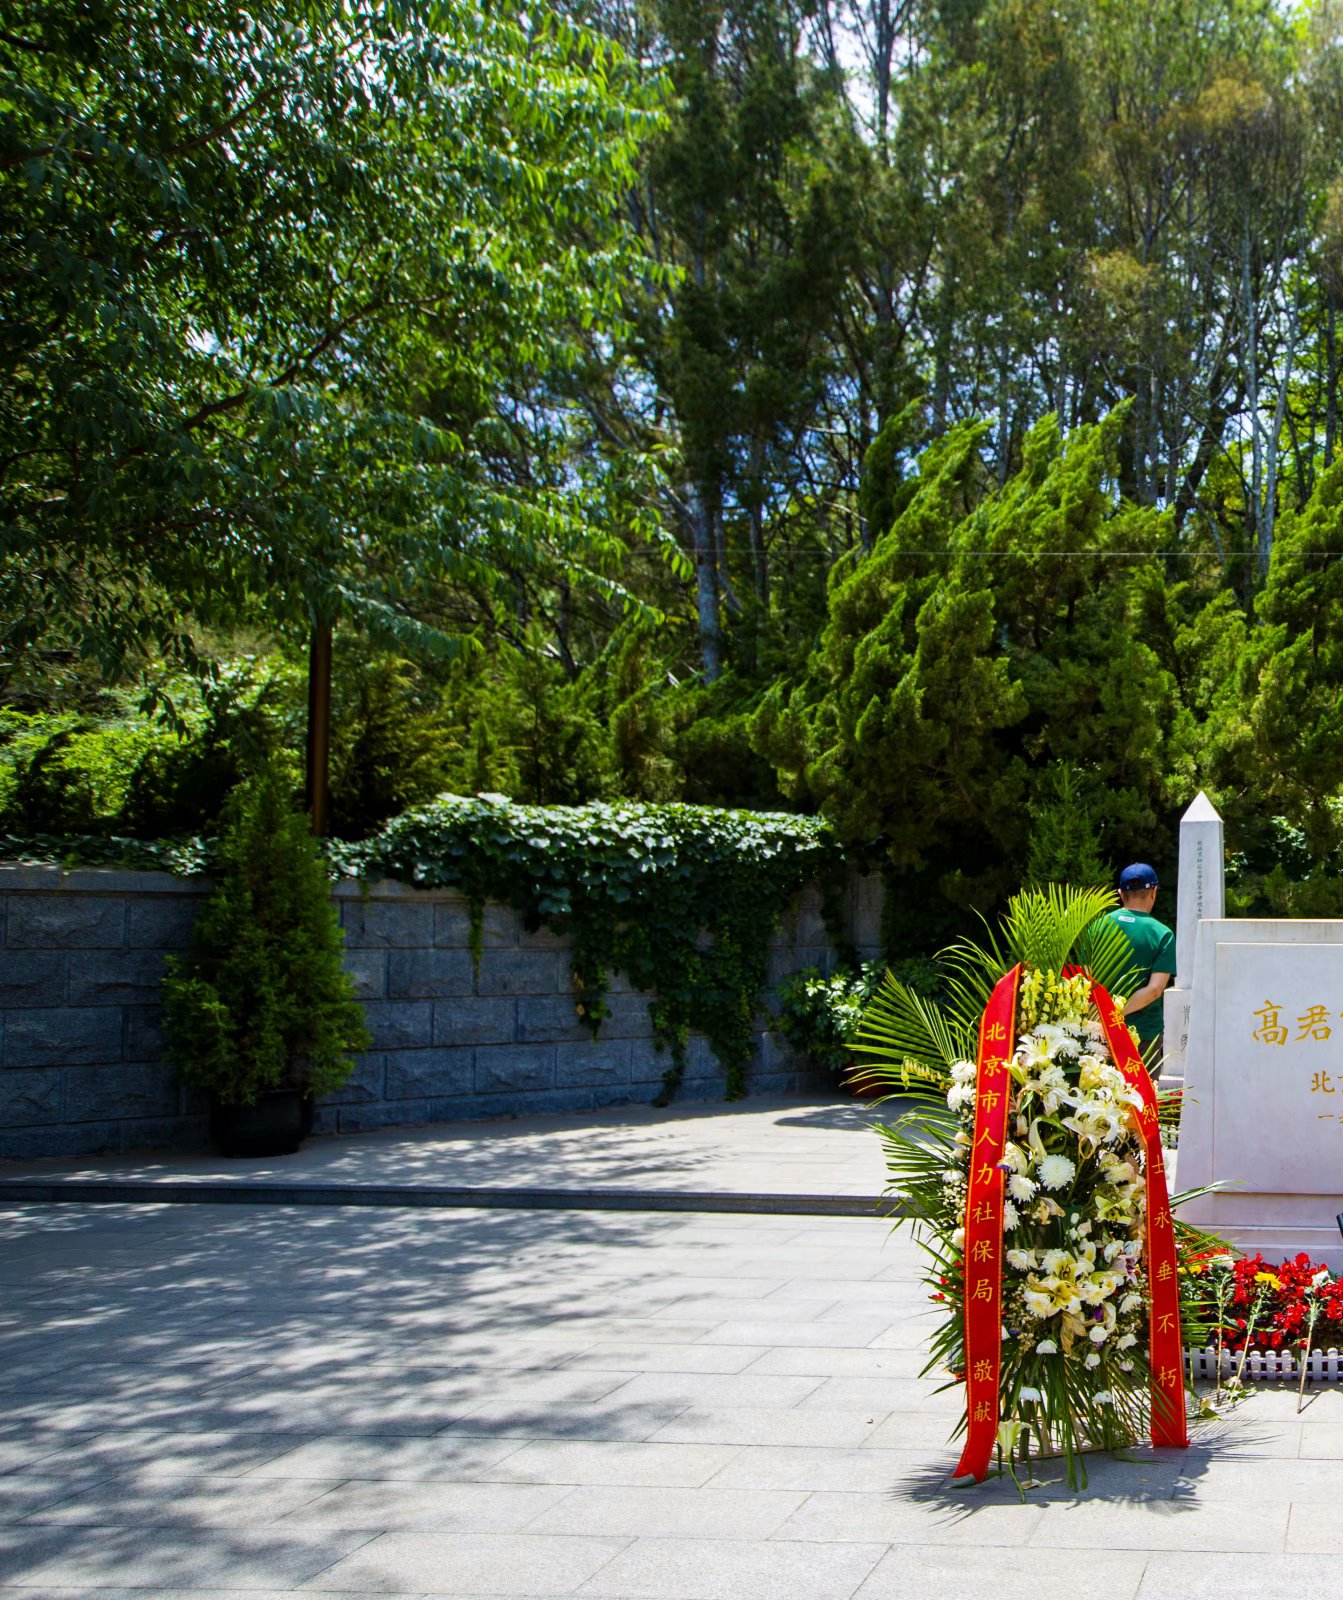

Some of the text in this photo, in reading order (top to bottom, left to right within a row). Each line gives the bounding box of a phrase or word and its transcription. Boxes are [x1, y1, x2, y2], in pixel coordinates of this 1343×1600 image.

[971, 1021, 1007, 1423] 北京市人力社保局 敬献
[1108, 1009, 1178, 1389] 革命烈士永垂不朽
